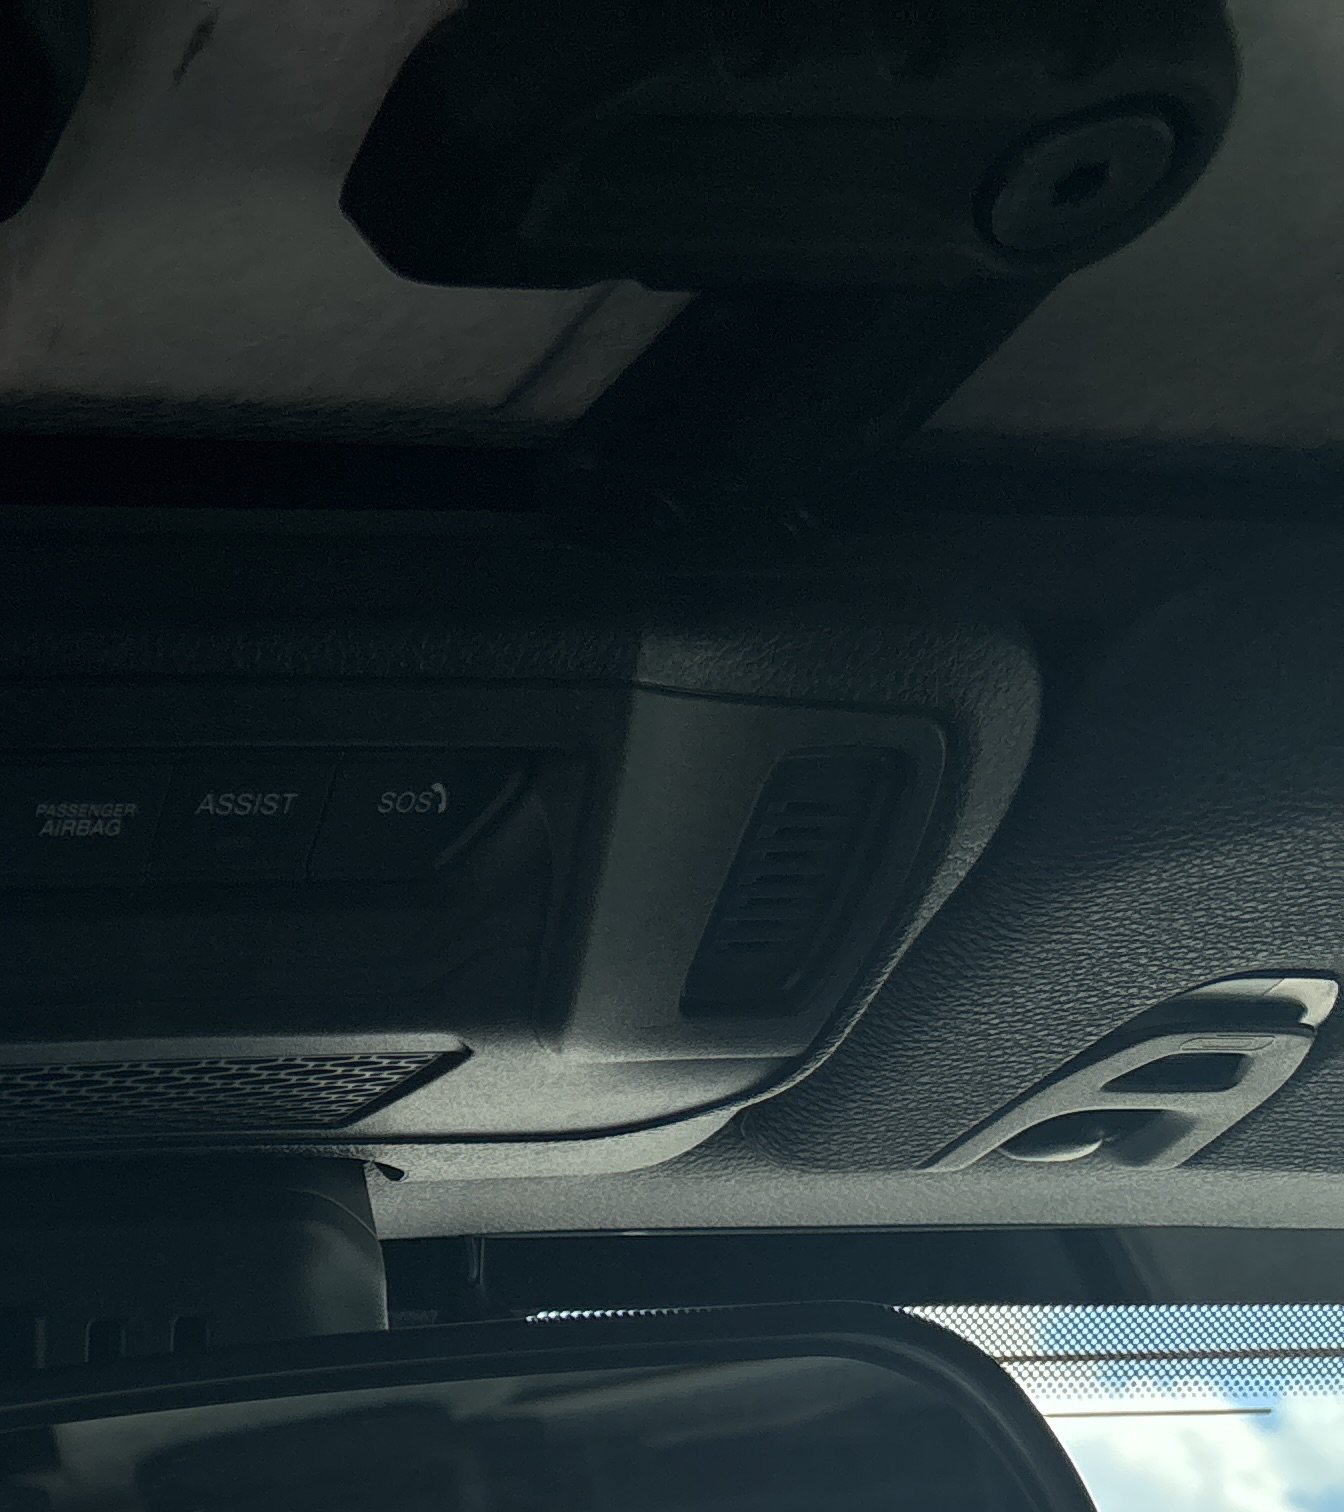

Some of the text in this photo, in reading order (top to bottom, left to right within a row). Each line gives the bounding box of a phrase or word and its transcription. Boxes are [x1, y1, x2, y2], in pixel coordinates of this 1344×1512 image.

[35, 802, 137, 818] PASSENGER
[195, 792, 298, 815] ASSIST
[377, 791, 434, 813] SOS
[39, 820, 122, 837] AIRBAG
